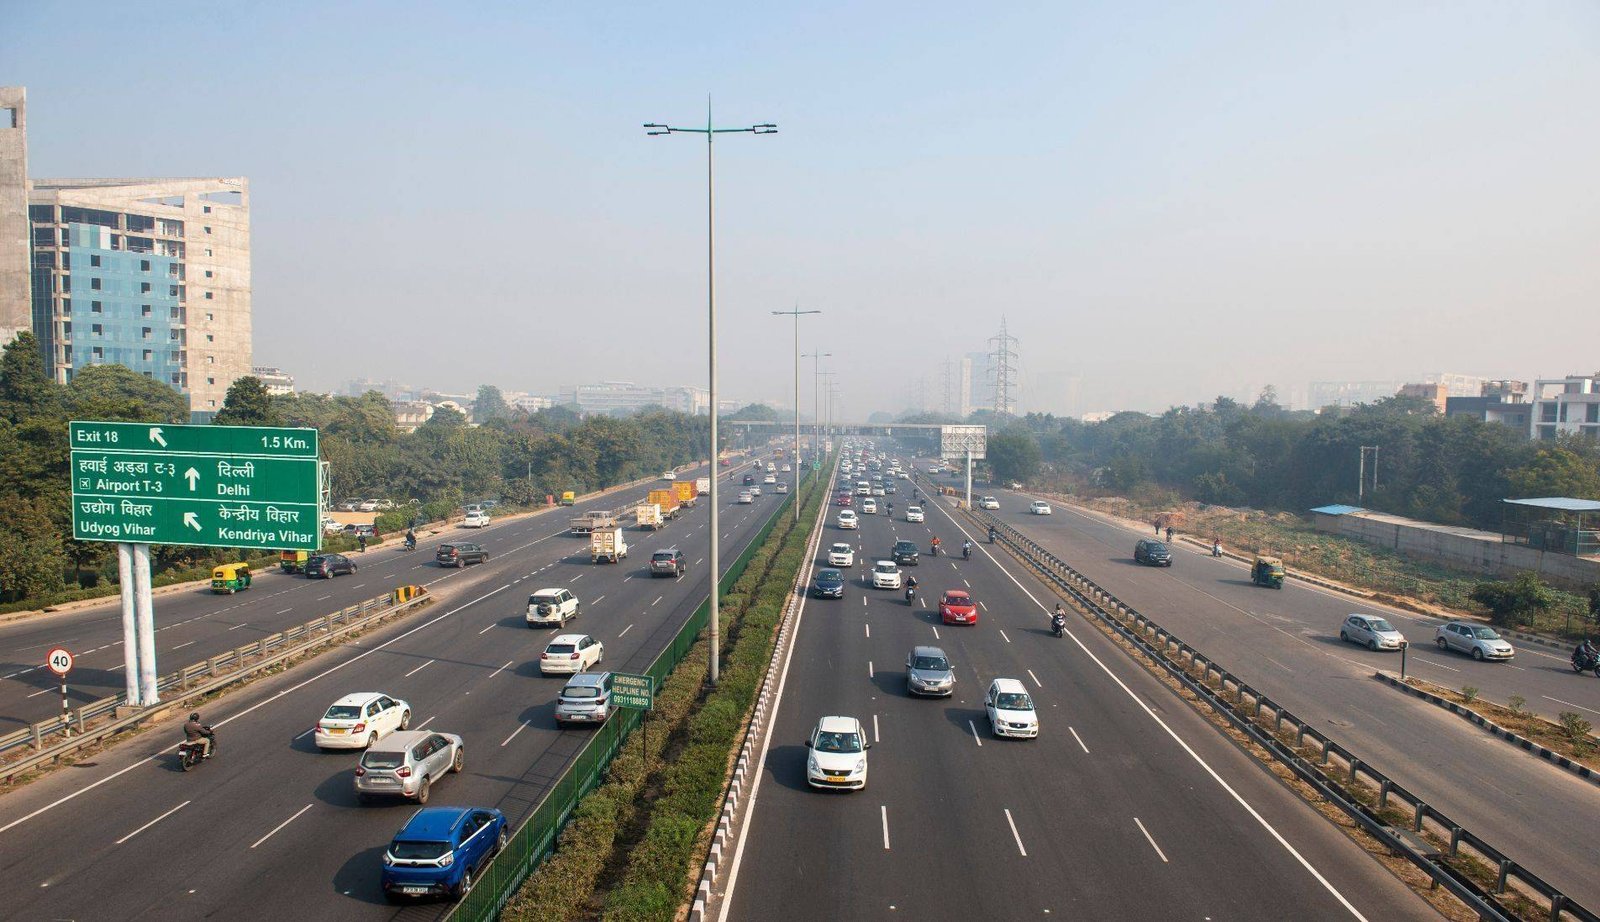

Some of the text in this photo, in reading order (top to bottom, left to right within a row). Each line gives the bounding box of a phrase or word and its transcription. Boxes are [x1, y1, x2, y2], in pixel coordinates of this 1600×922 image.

[77, 429, 118, 442] Exit 18
[262, 436, 309, 449] 1.5 Km.
[79, 456, 107, 474] हवाई
[217, 461, 254, 477] दिल्ली
[96, 479, 162, 494] Airport T-3
[218, 483, 250, 496] Delhi
[81, 499, 153, 516] उद्योग विहार
[219, 503, 300, 523] केन्द्रीय विहार
[80, 521, 156, 536] Udyog Vihar
[219, 528, 313, 543] Kendriya Vihar
[53, 656, 68, 667] 40
[614, 676, 649, 687] EMERGENCY
[612, 685, 640, 696] HELPLINE
